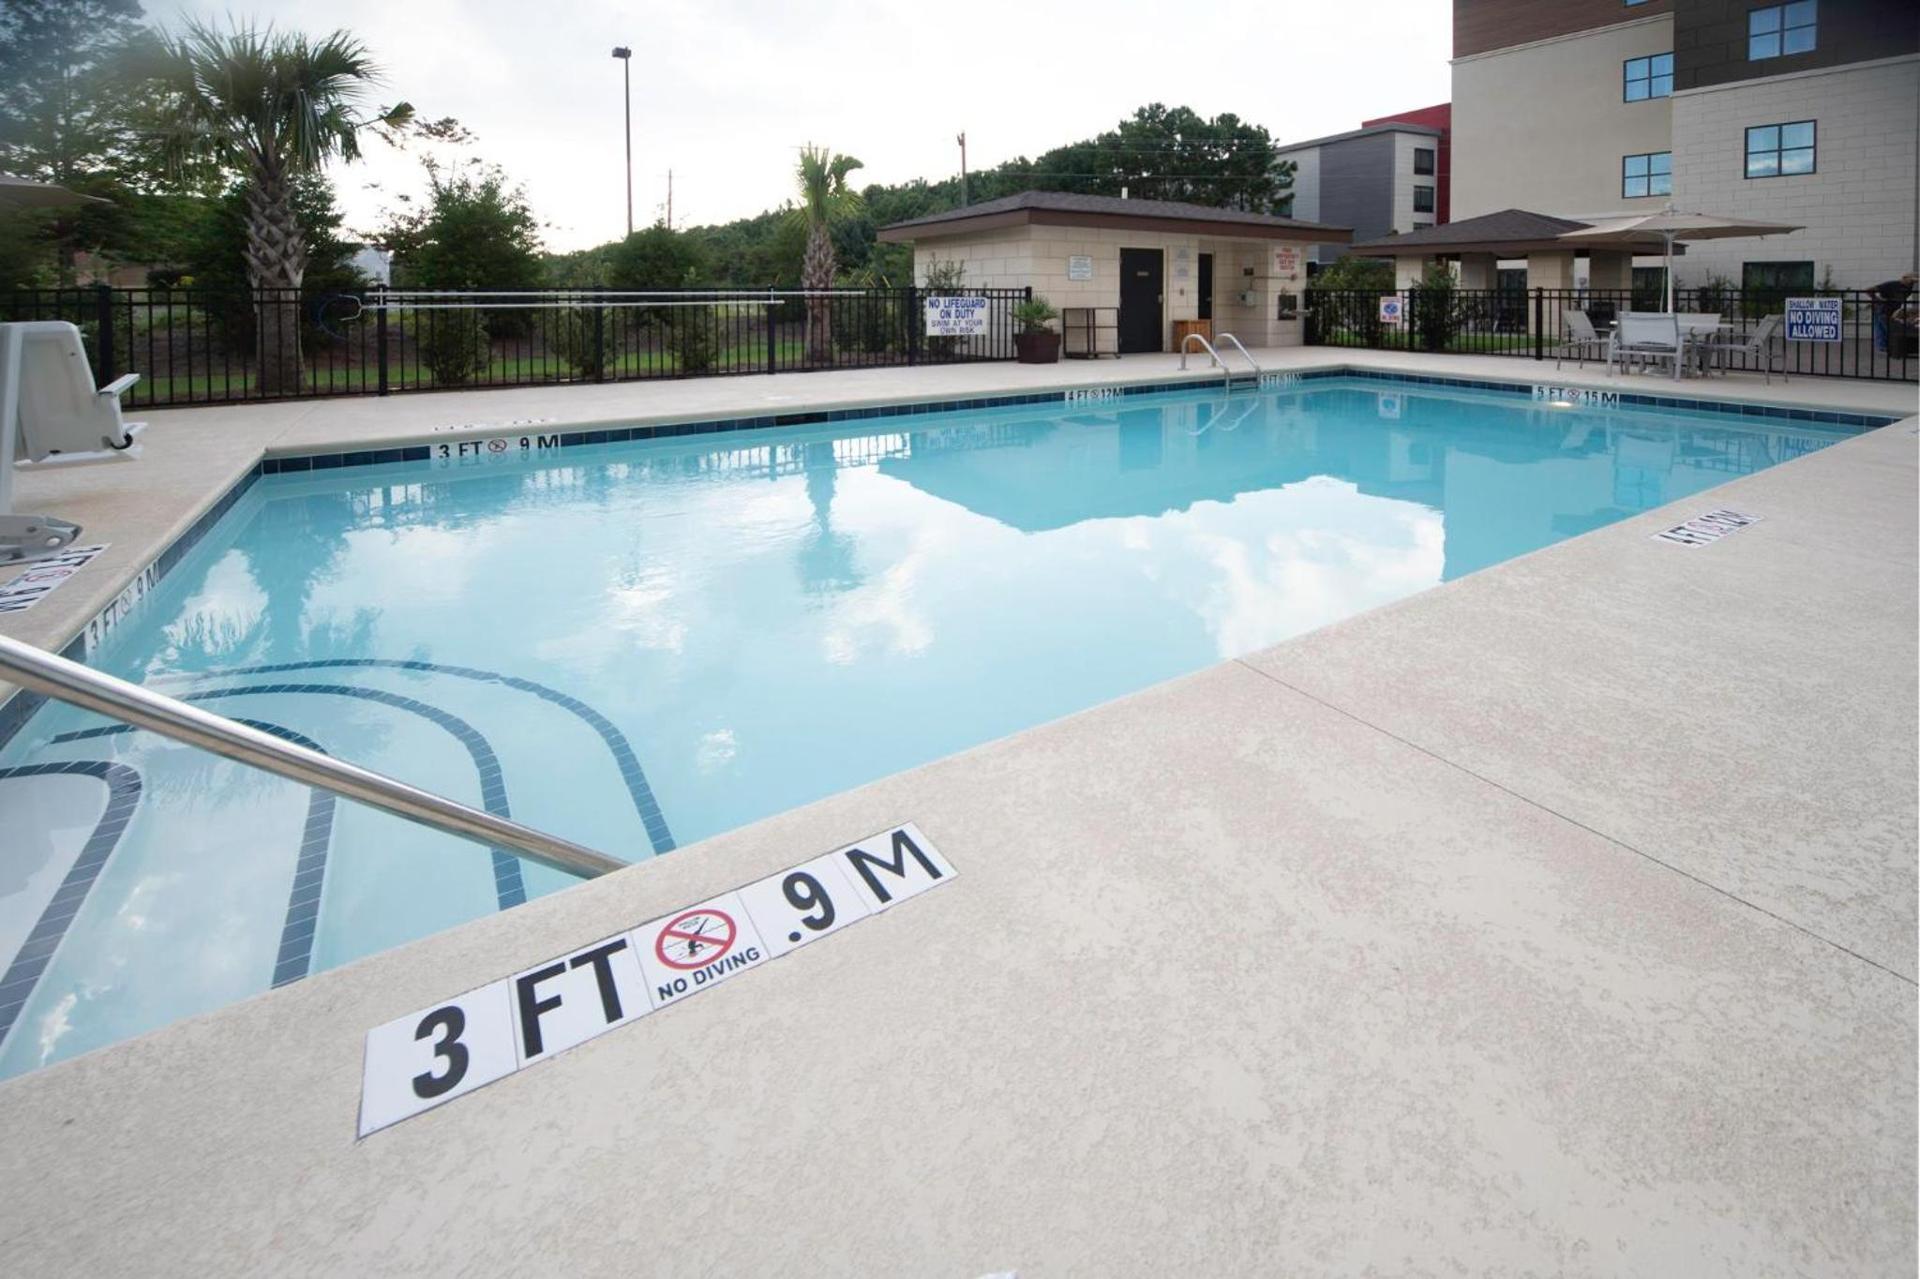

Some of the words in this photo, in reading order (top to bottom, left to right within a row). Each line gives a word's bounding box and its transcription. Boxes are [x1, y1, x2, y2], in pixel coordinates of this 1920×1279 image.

[928, 298, 940, 309] NO
[944, 298, 986, 309] LIFEGUARD
[940, 309, 951, 319] ON
[955, 309, 975, 319] DUTY
[1790, 311, 1803, 324] NO
[1805, 311, 1838, 324] DIVING
[1792, 324, 1837, 338] ALLOWED
[1077, 390, 1088, 400] FT
[1537, 386, 1544, 398] 5
[1549, 387, 1565, 401] FT
[438, 444, 450, 459] 3
[458, 441, 482, 457] FT
[519, 437, 530, 451] 9
[537, 434, 559, 449] M
[103, 598, 119, 636] FT
[412, 1005, 470, 1100] 3
[516, 938, 628, 1060] FT
[781, 872, 837, 943] .9
[846, 829, 943, 904] M
[657, 977, 688, 1001] NO
[692, 946, 761, 986] DIVING
